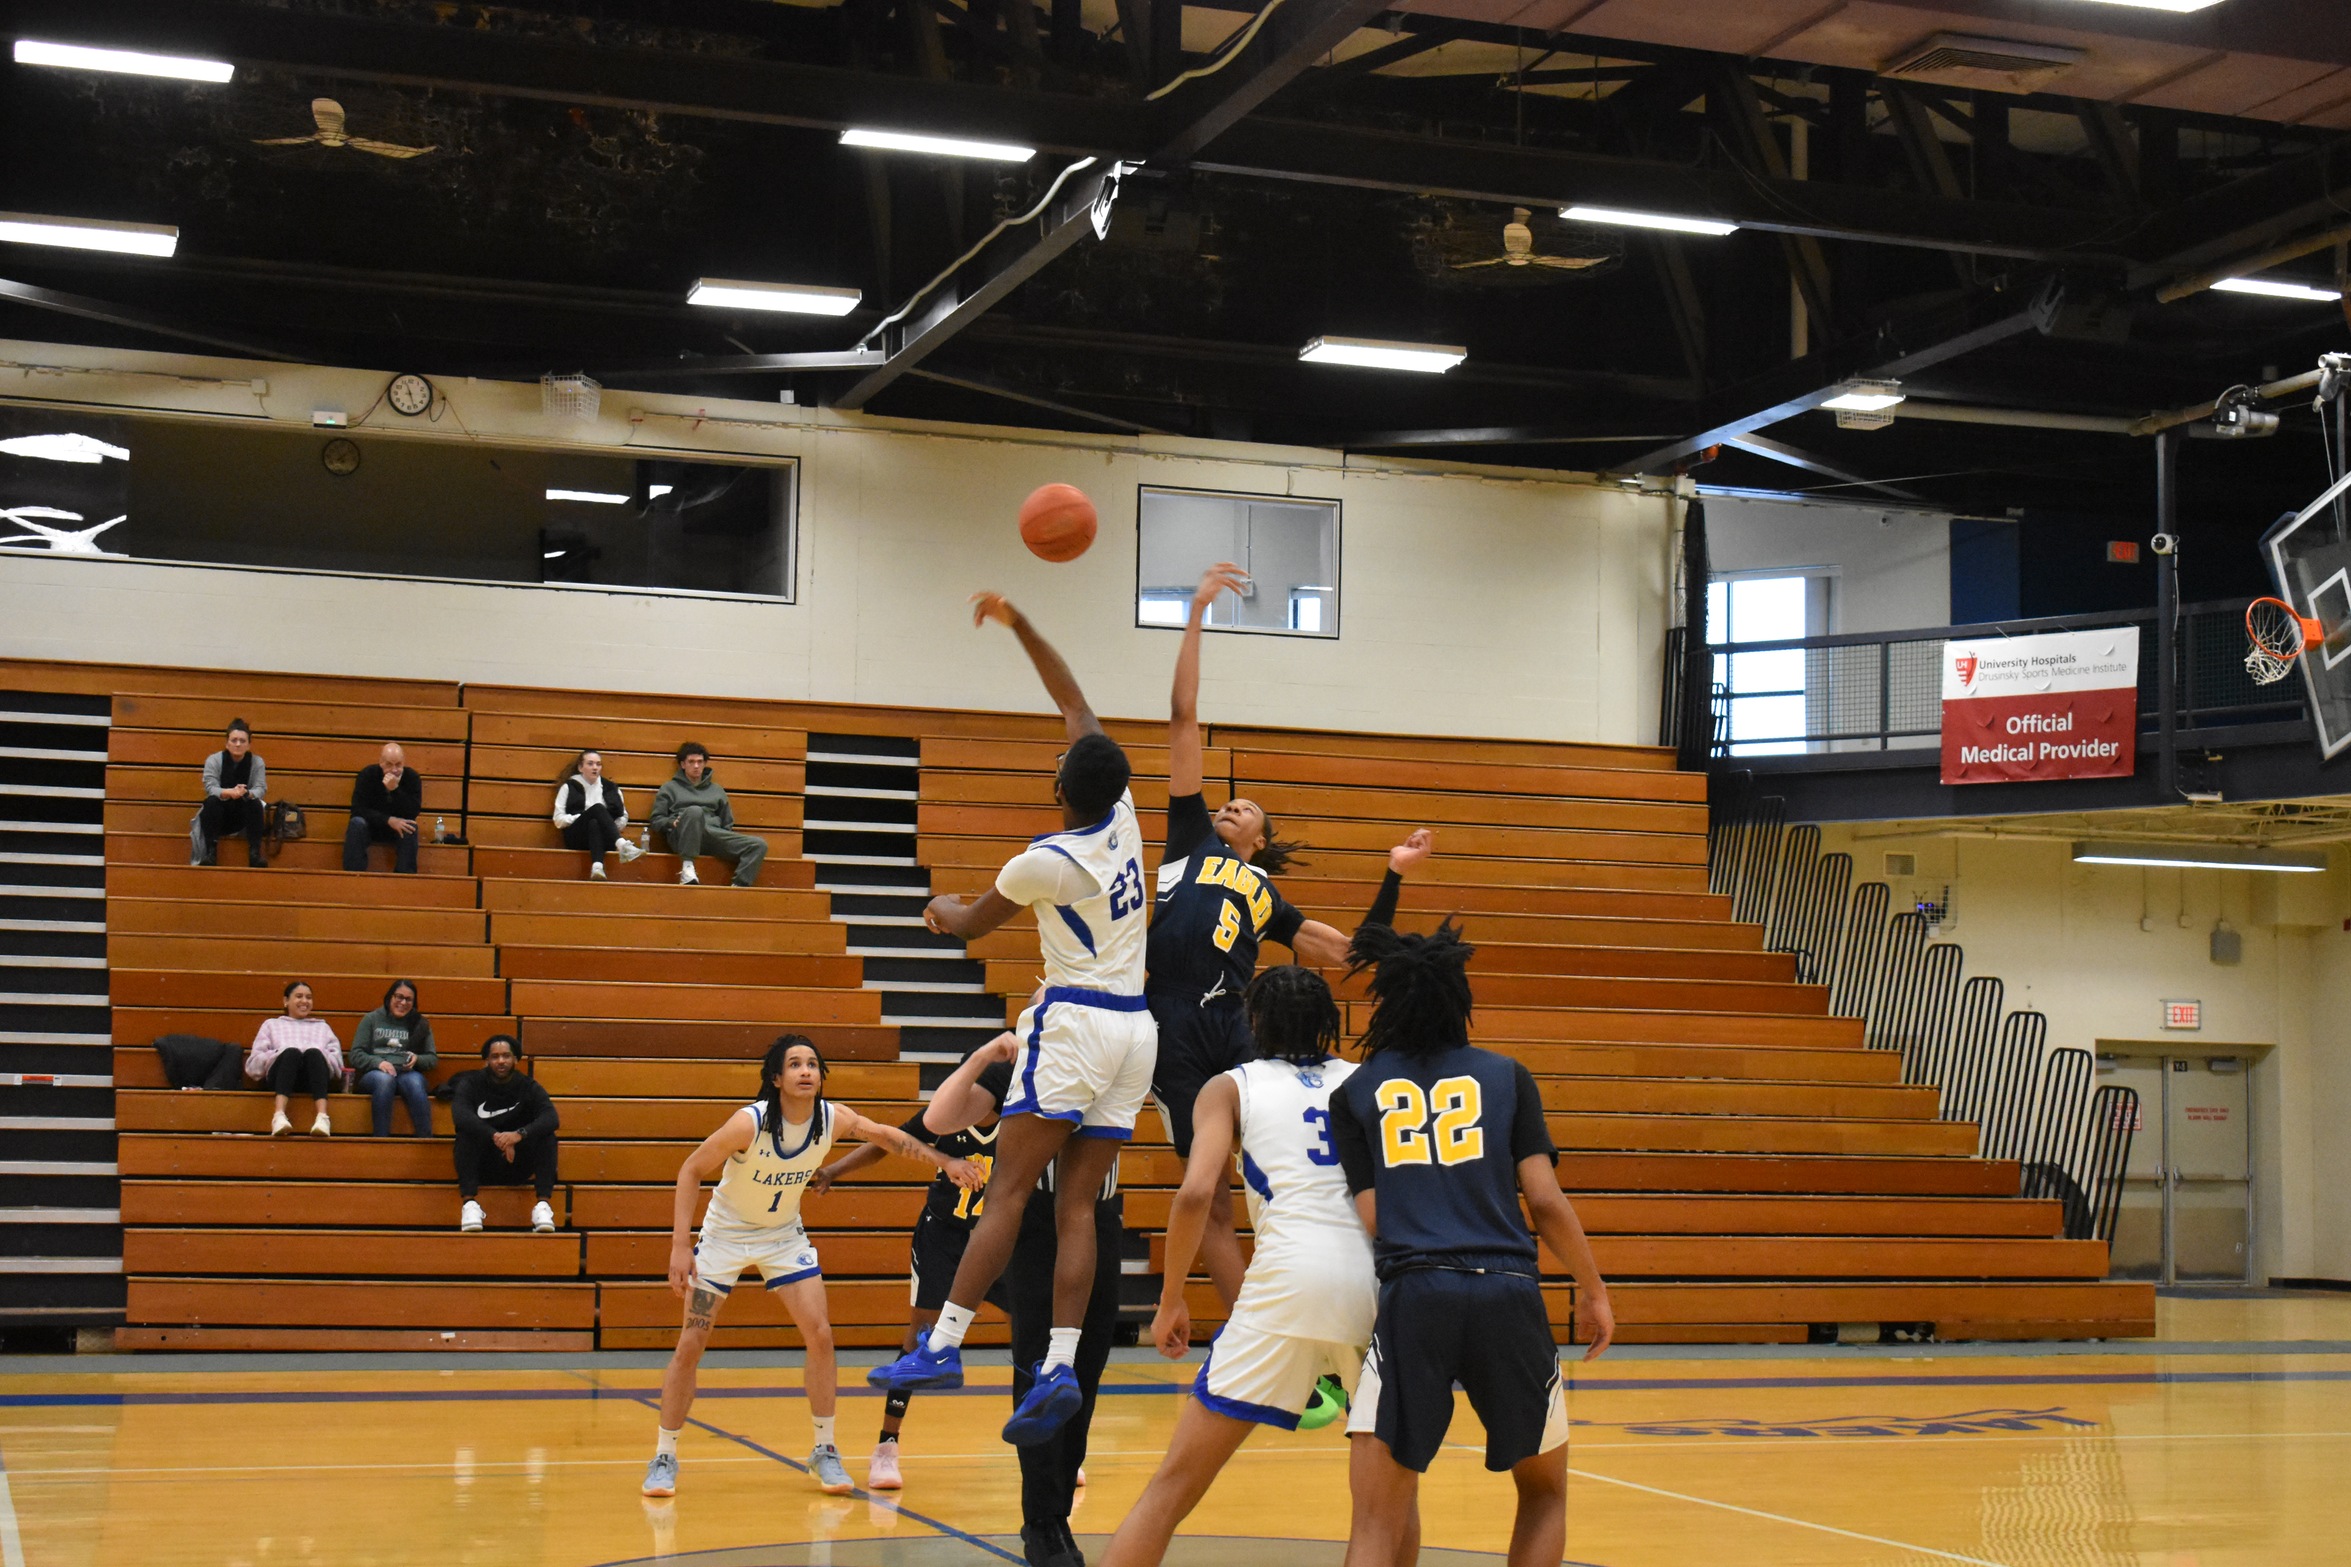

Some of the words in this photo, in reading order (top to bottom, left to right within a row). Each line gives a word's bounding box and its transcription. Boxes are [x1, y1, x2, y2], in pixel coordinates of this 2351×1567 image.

[1957, 661, 1968, 669] UH
[1978, 669, 2019, 682] Drusinsky
[2021, 669, 2049, 680] Sports
[2051, 666, 2090, 677] Medicine
[2092, 662, 2127, 673] Institute
[1979, 658, 2028, 670] University
[2031, 653, 2077, 666] Hospitals
[2006, 712, 2073, 735] Official
[1961, 742, 2034, 763] Medical
[2039, 738, 2119, 760] Provider
[1109, 857, 1144, 921] 23
[1212, 898, 1241, 953] 5
[2172, 1006, 2194, 1023] EXIT
[1375, 1075, 1484, 1168] 22
[1303, 1106, 1340, 1166] 3
[767, 1190, 783, 1212] 1
